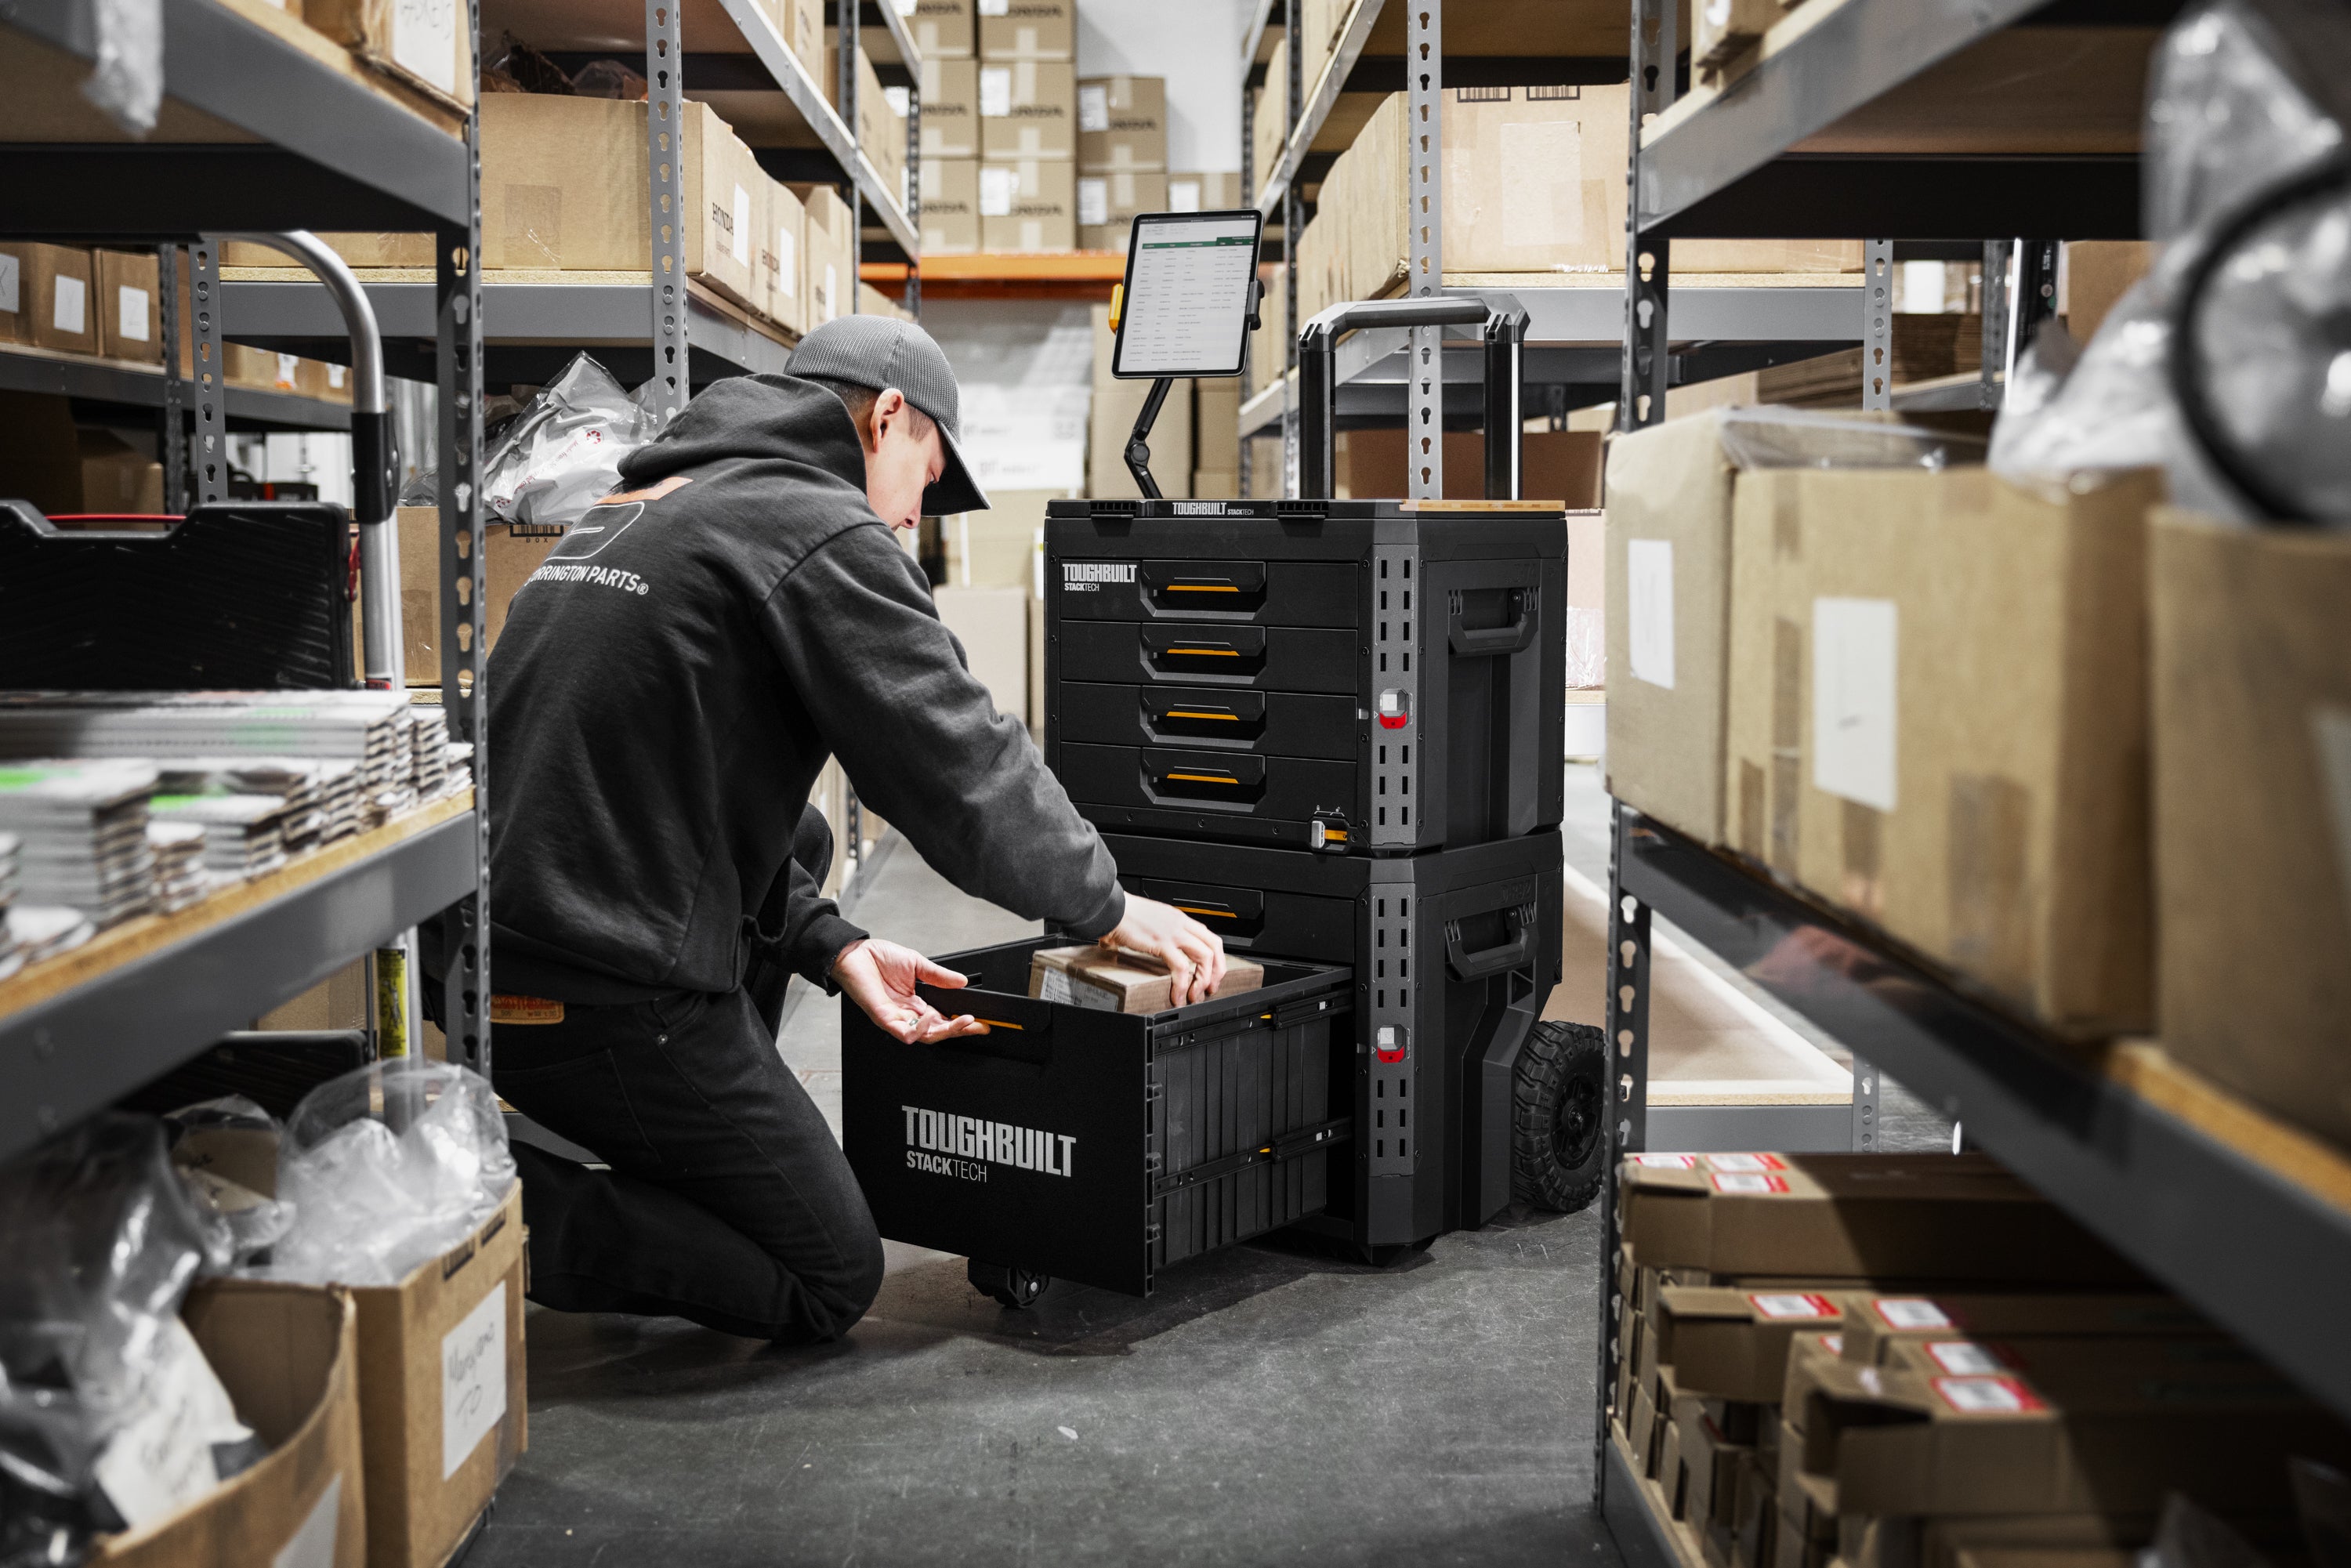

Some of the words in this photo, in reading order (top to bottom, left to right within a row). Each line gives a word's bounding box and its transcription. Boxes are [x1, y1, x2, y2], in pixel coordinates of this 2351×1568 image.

[712, 202, 734, 236] HONDA
[1172, 502, 1227, 516] TOUGHBUILT
[524, 565, 590, 586] ORRINGTON
[1062, 564, 1137, 583] TOUGHBUILT
[1064, 582, 1099, 592] STACKTECH
[901, 1105, 1077, 1178] TOUGHBUILT
[907, 1150, 987, 1183] STACKTECH
